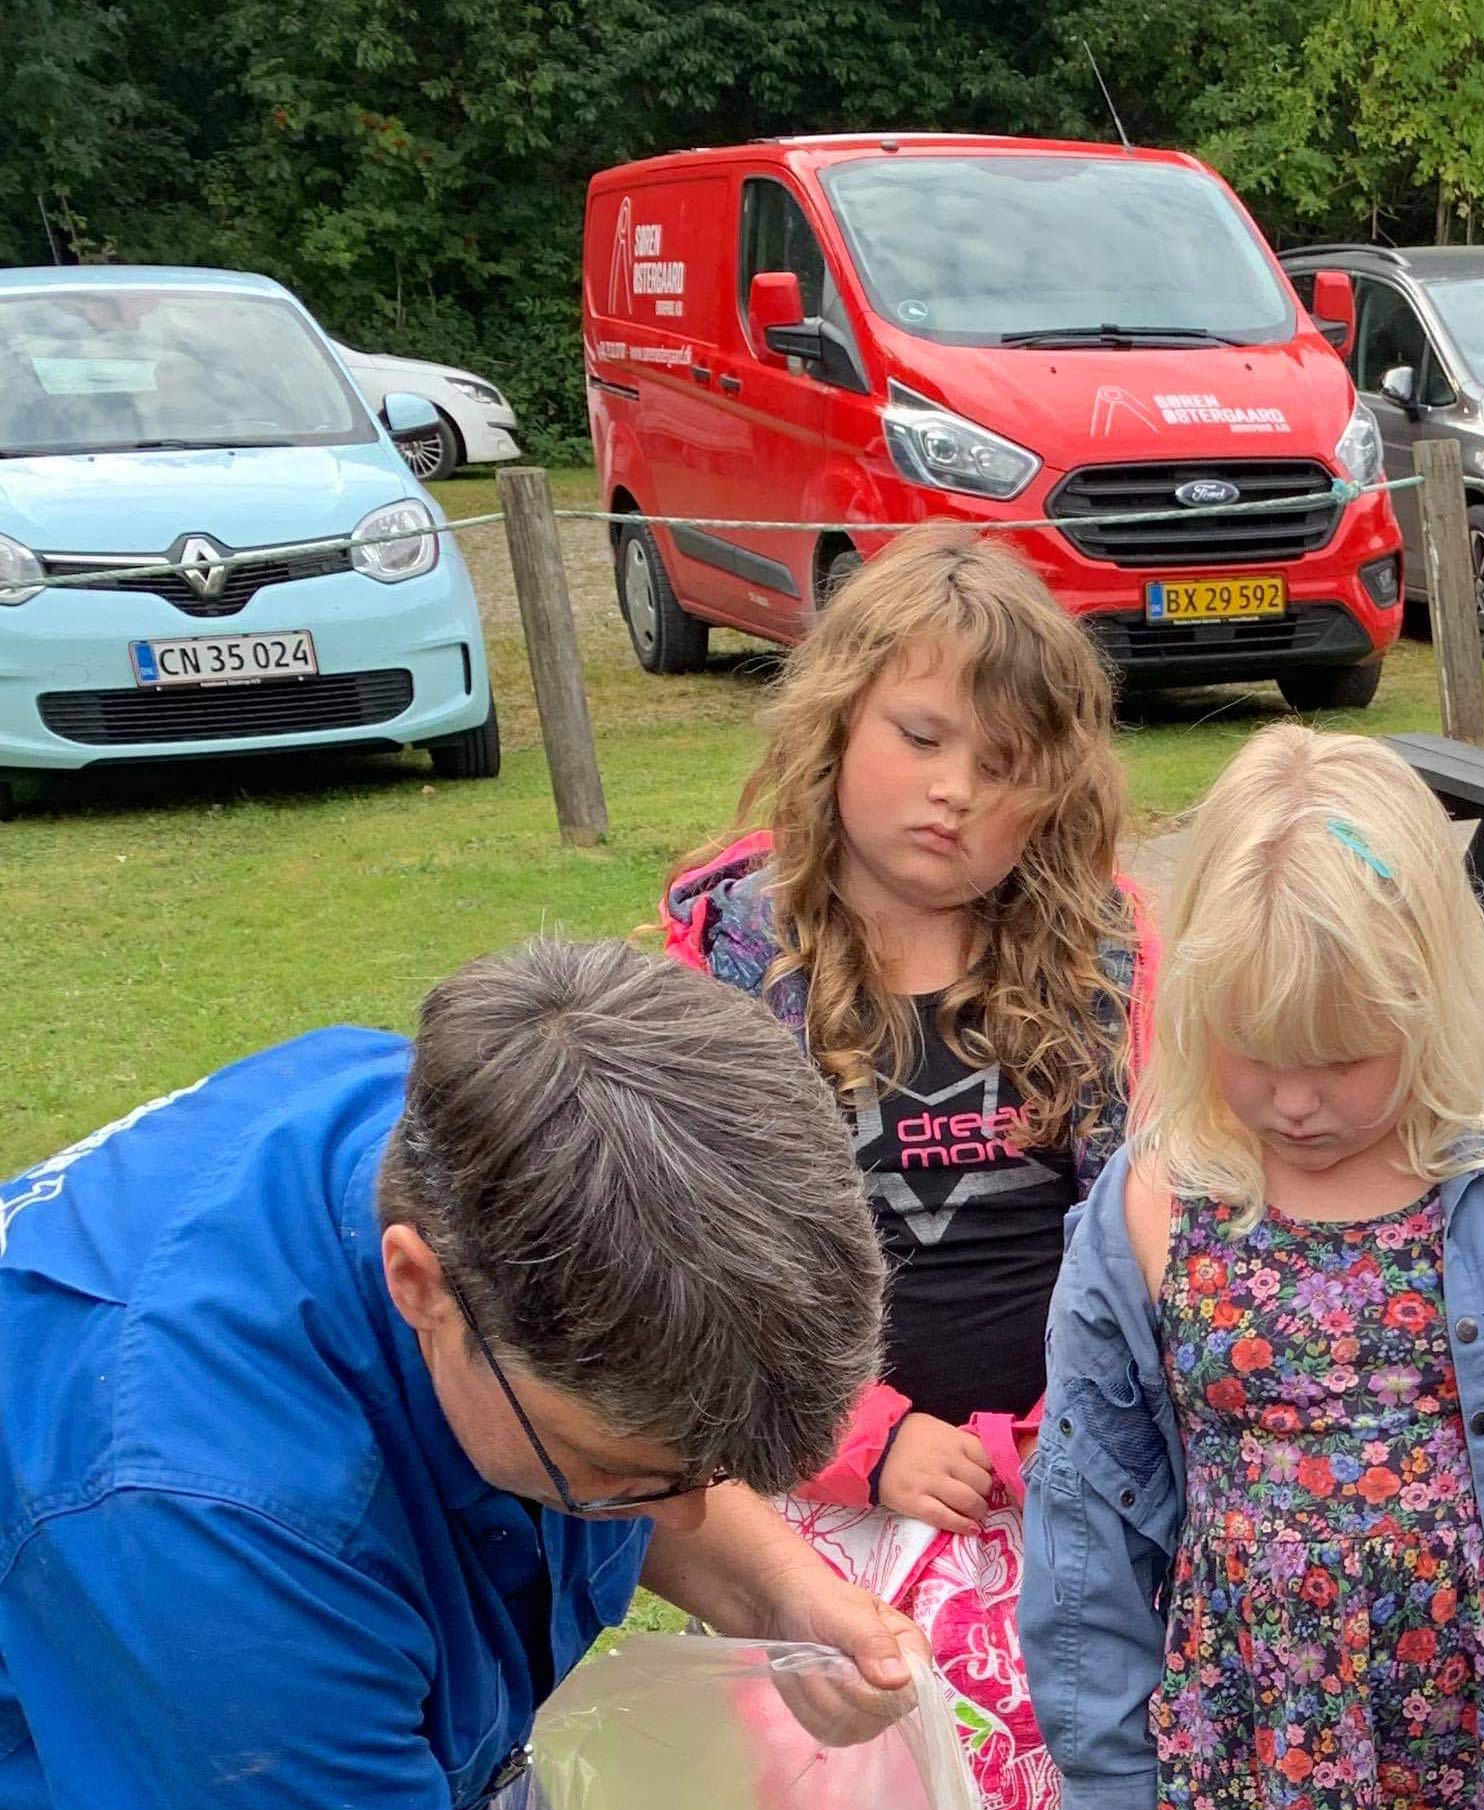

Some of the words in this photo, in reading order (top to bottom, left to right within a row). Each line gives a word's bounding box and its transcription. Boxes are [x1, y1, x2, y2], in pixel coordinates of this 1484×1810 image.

[1166, 587, 1197, 613] BX
[1204, 586, 1232, 611] 29
[1239, 584, 1279, 609] 592
[159, 647, 201, 675] CN
[206, 644, 245, 673] 35
[252, 639, 309, 669] 024
